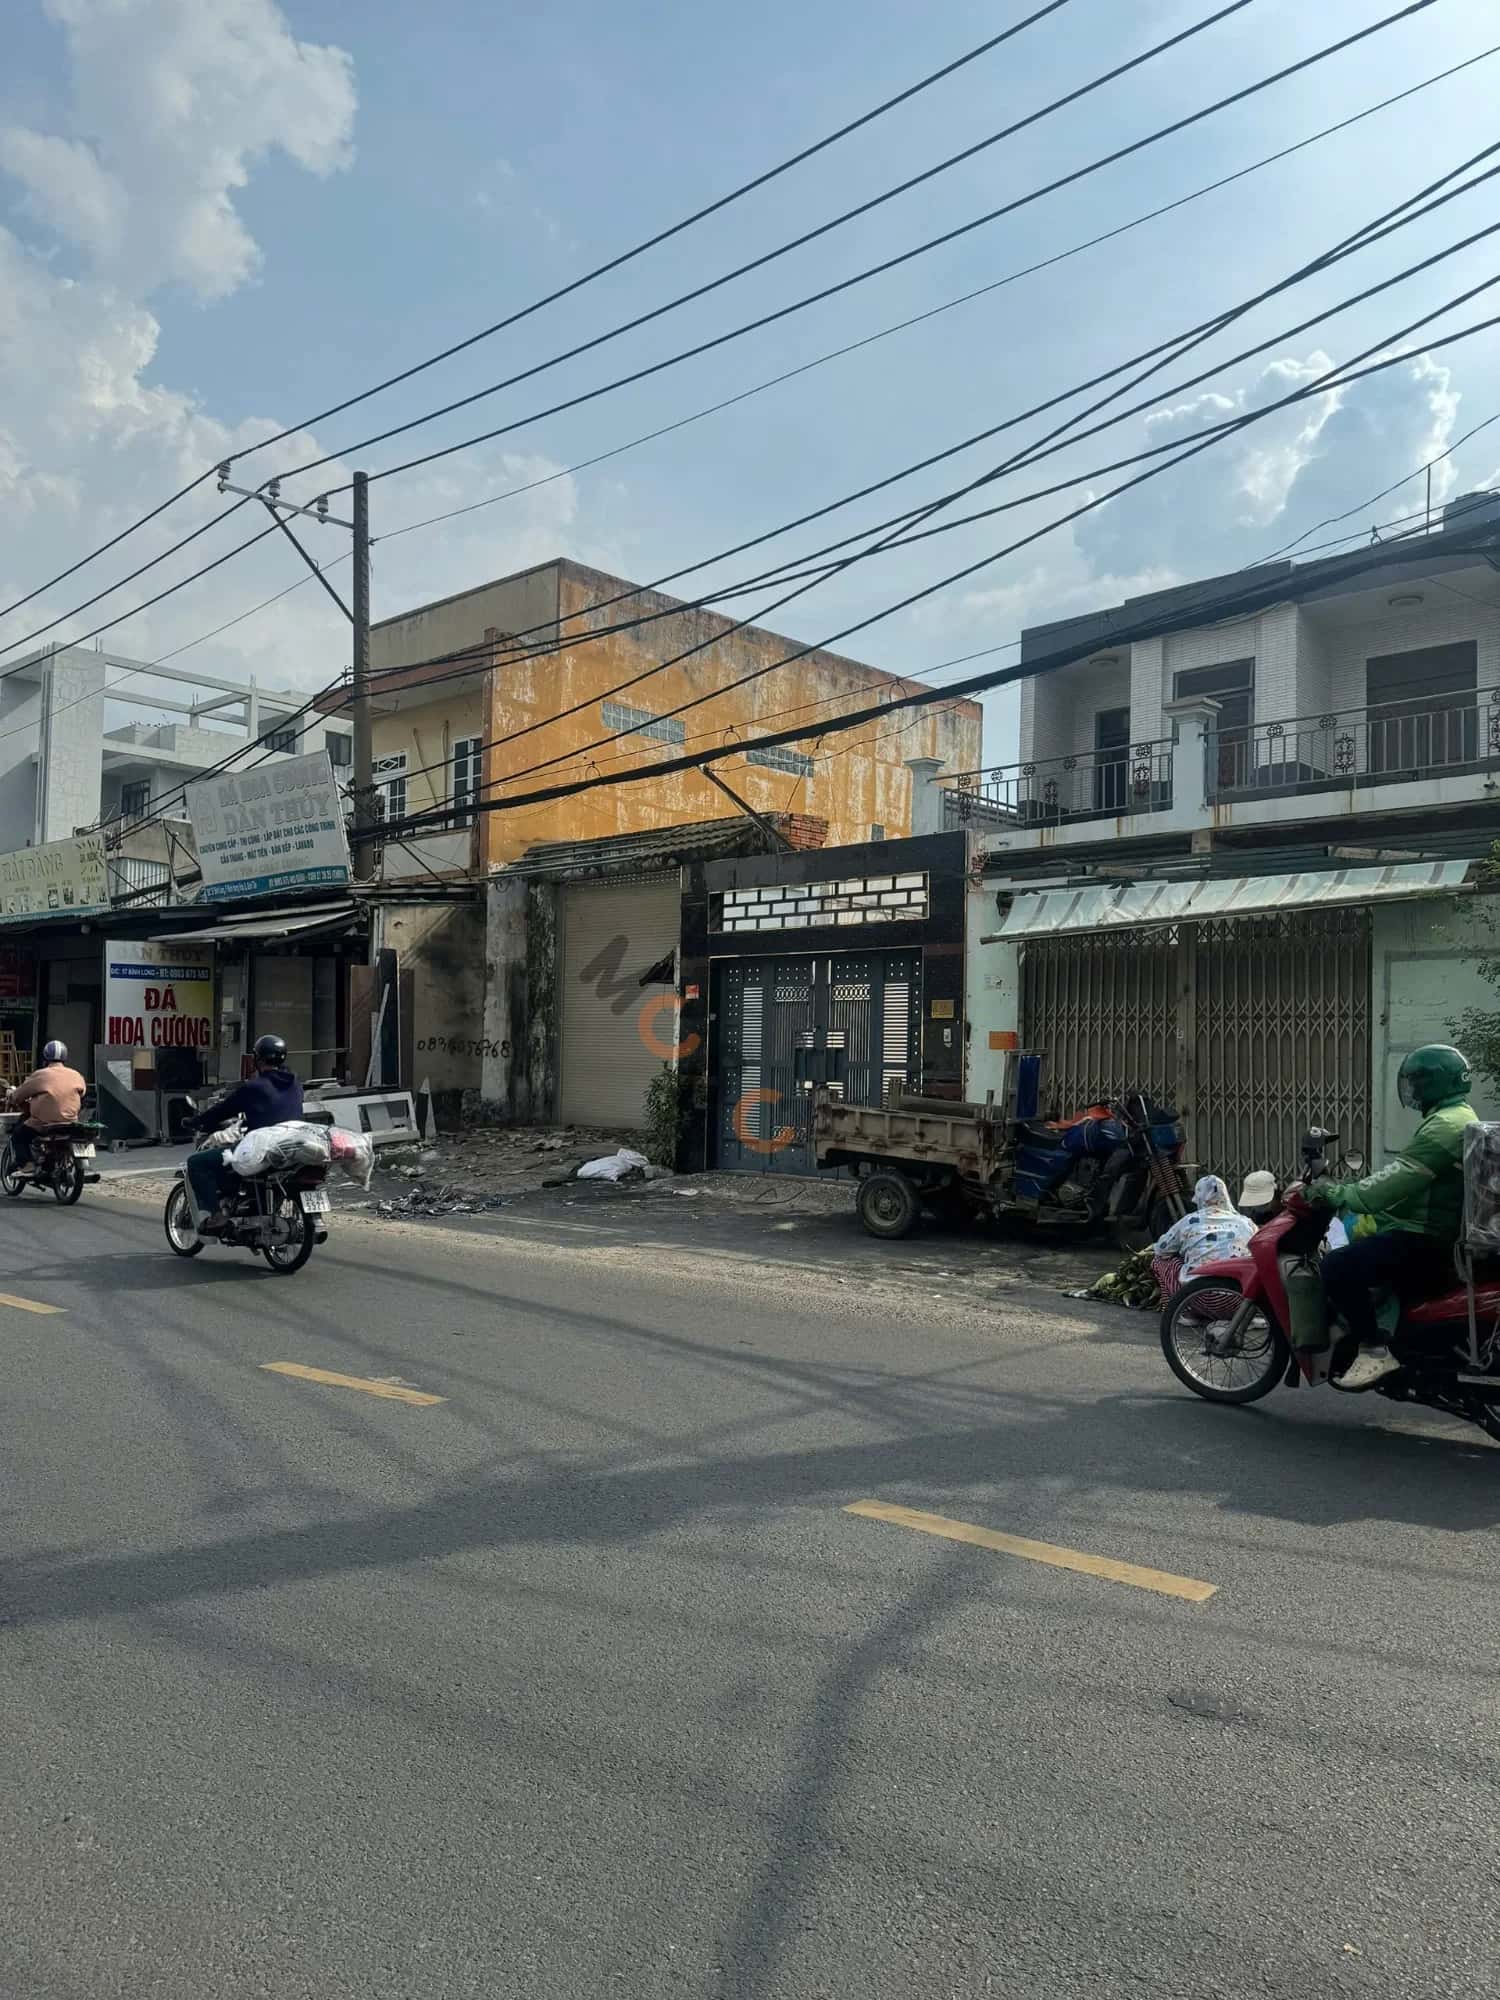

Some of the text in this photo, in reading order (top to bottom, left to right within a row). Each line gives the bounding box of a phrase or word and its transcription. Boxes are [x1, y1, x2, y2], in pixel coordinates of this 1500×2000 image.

[144, 983, 177, 1011] ĐÁ
[108, 1012, 210, 1047] HOA CƯƠNG
